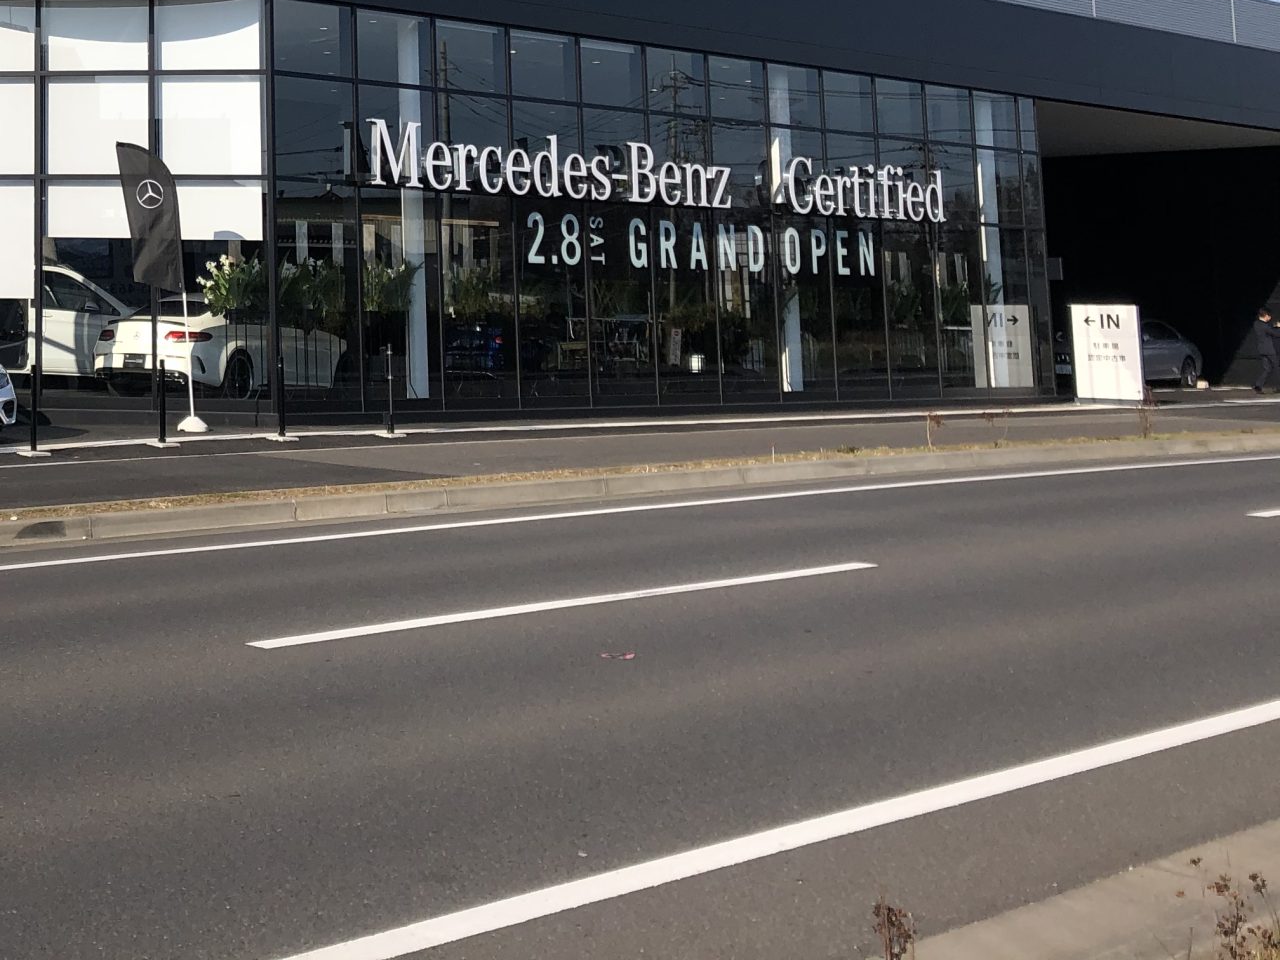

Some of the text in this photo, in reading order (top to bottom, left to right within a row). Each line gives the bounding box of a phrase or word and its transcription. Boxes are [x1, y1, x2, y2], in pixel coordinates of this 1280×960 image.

[366, 118, 947, 223] Mercedes-Benz Certified
[527, 211, 876, 277] 2.8 SAT GRAND OPEN
[1100, 313, 1120, 330] IN
